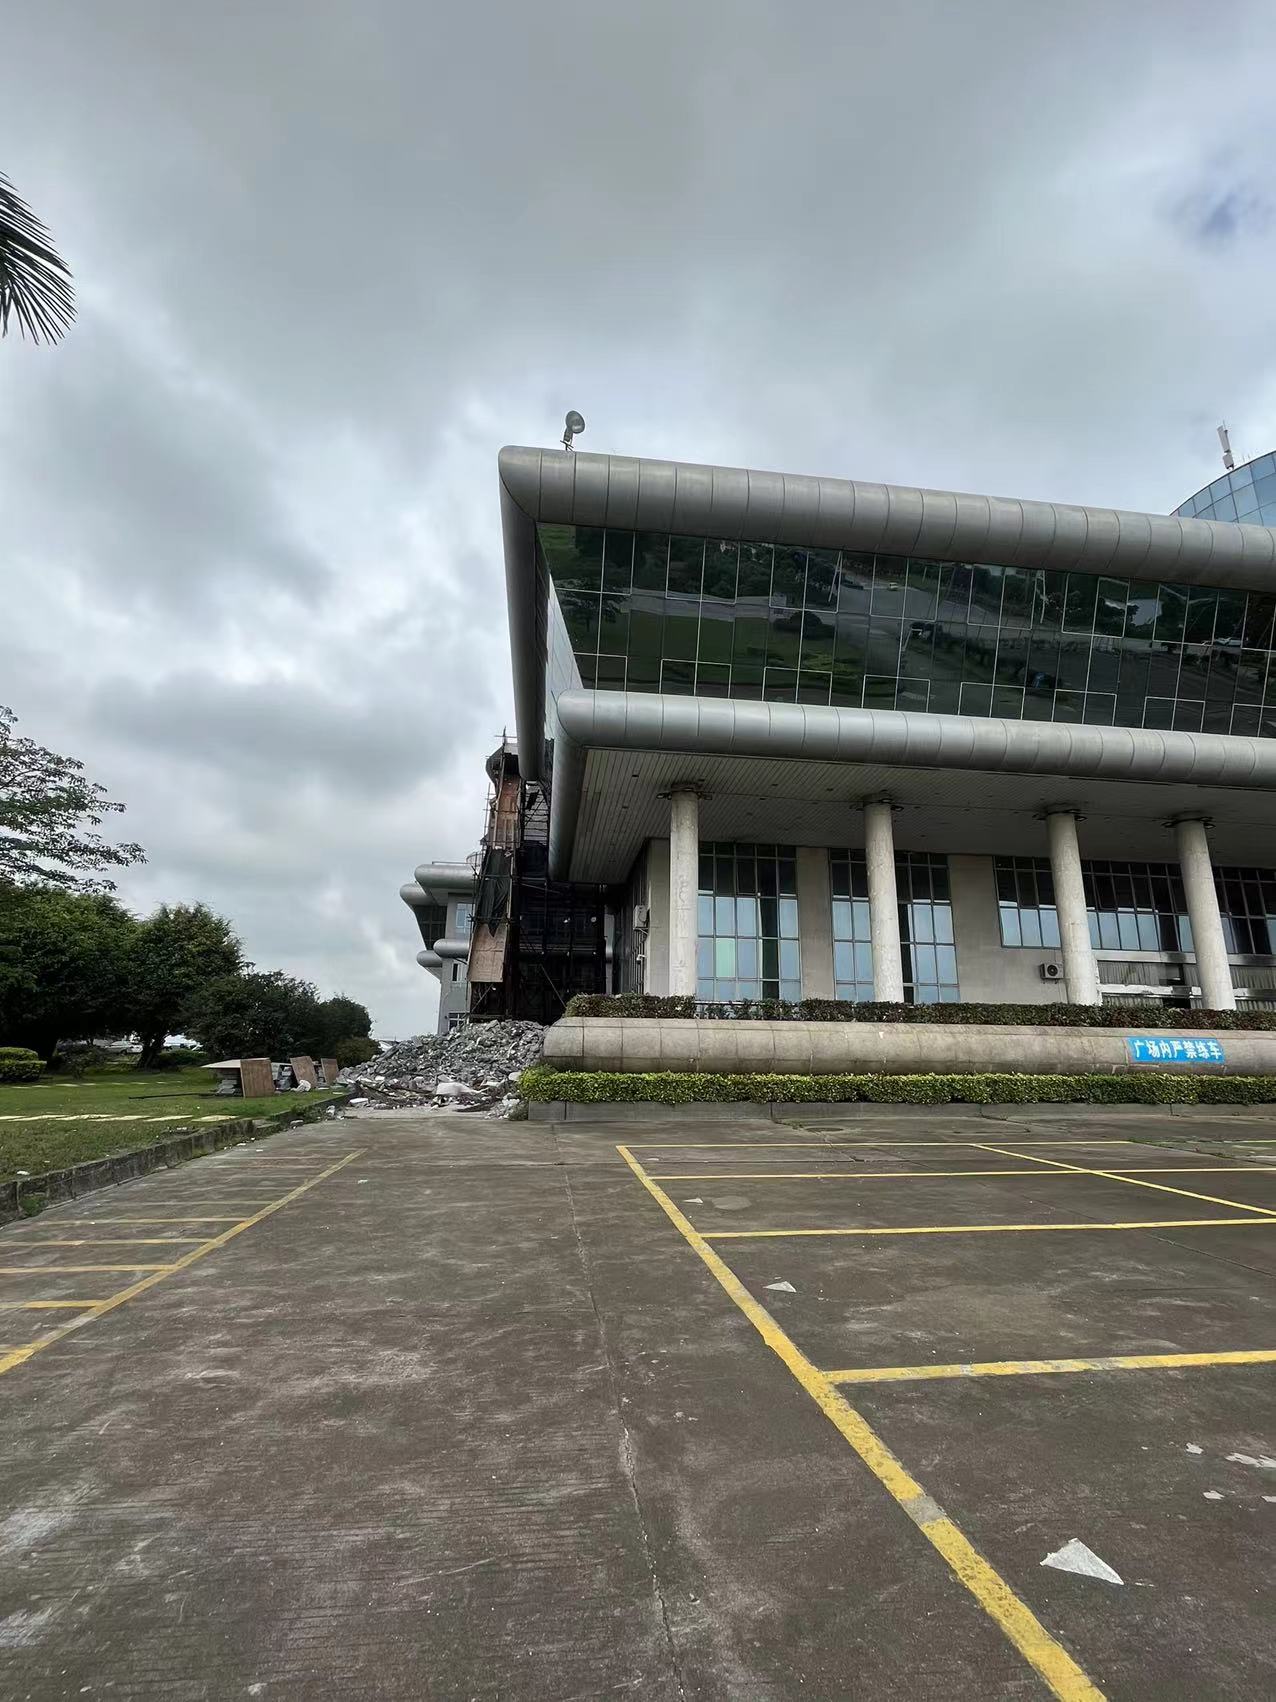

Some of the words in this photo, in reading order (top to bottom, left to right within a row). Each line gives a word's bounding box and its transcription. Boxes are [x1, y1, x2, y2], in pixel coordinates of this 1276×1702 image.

[1133, 1039, 1221, 1059] 广场内严禁练车
